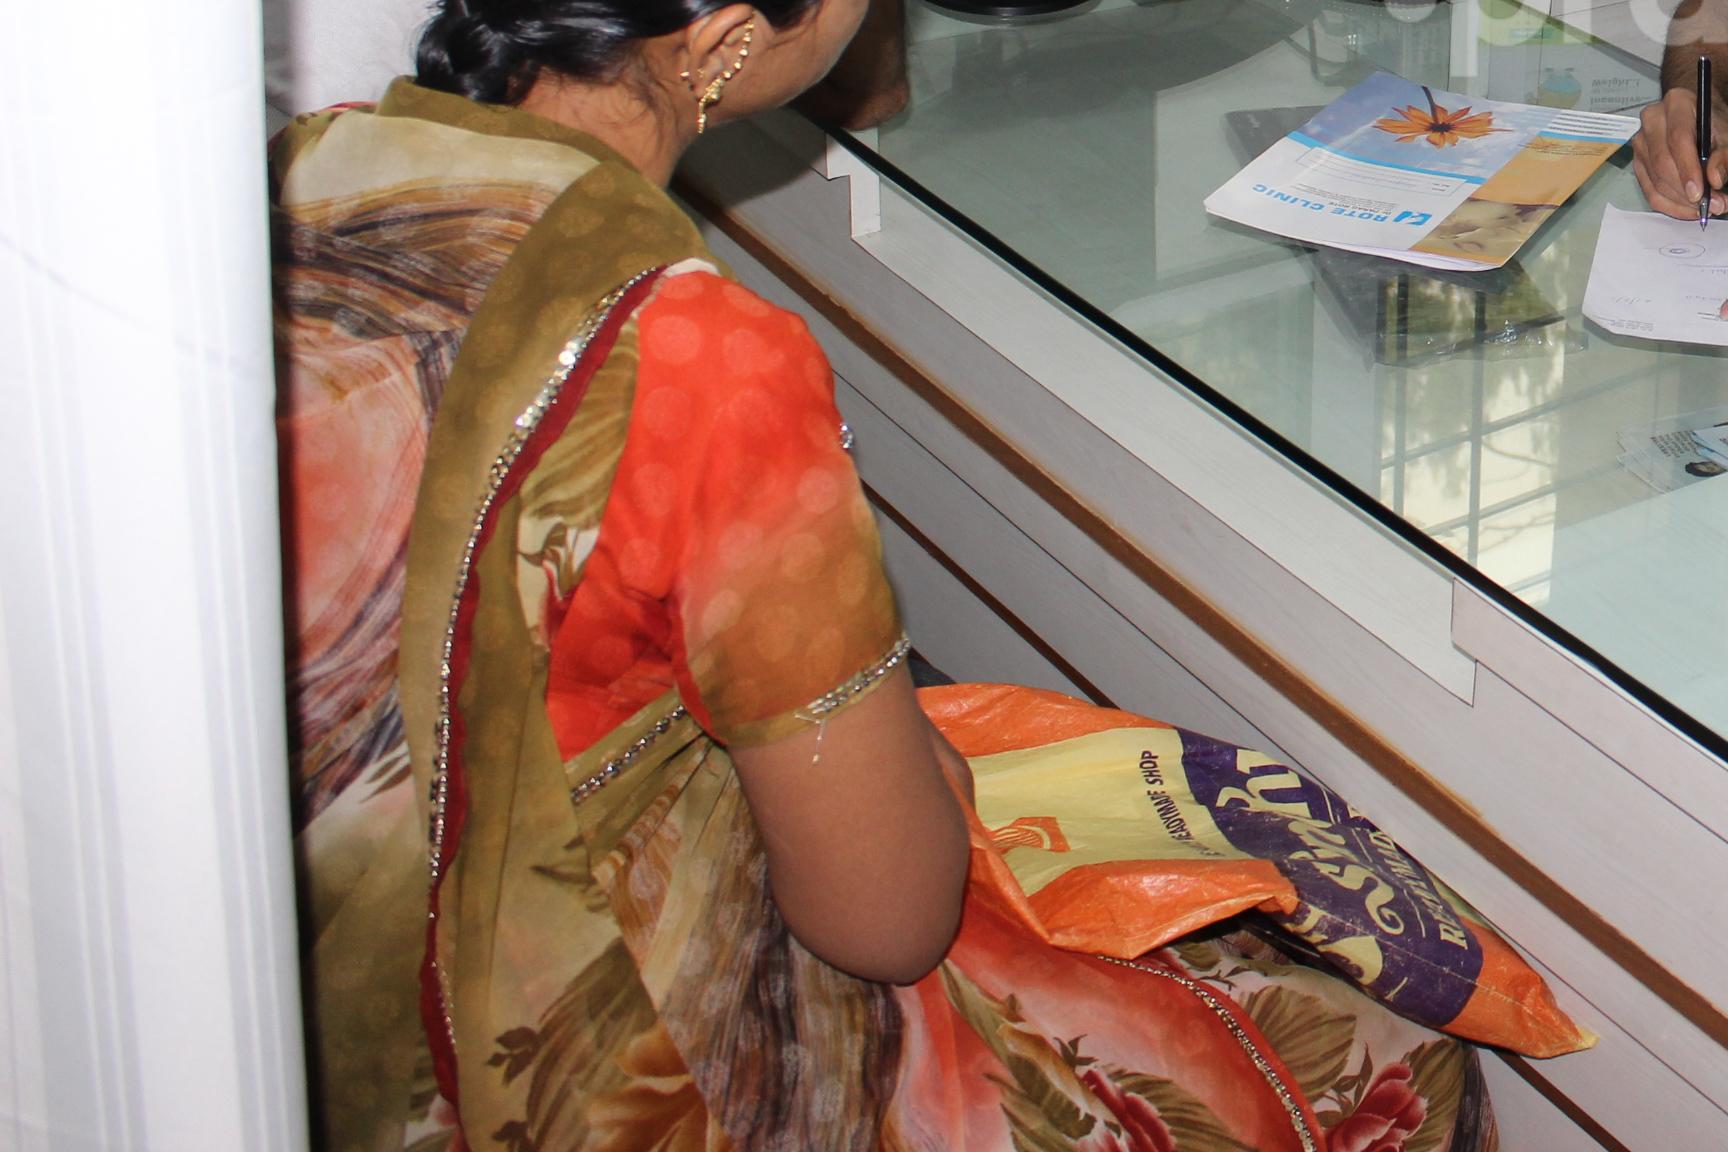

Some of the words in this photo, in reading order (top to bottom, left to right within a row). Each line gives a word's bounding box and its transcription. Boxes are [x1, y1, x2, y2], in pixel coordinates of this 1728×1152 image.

[1252, 184, 1325, 211] CLINIC
[1331, 207, 1389, 223] ROTE
[1139, 751, 1164, 786] SHOP
